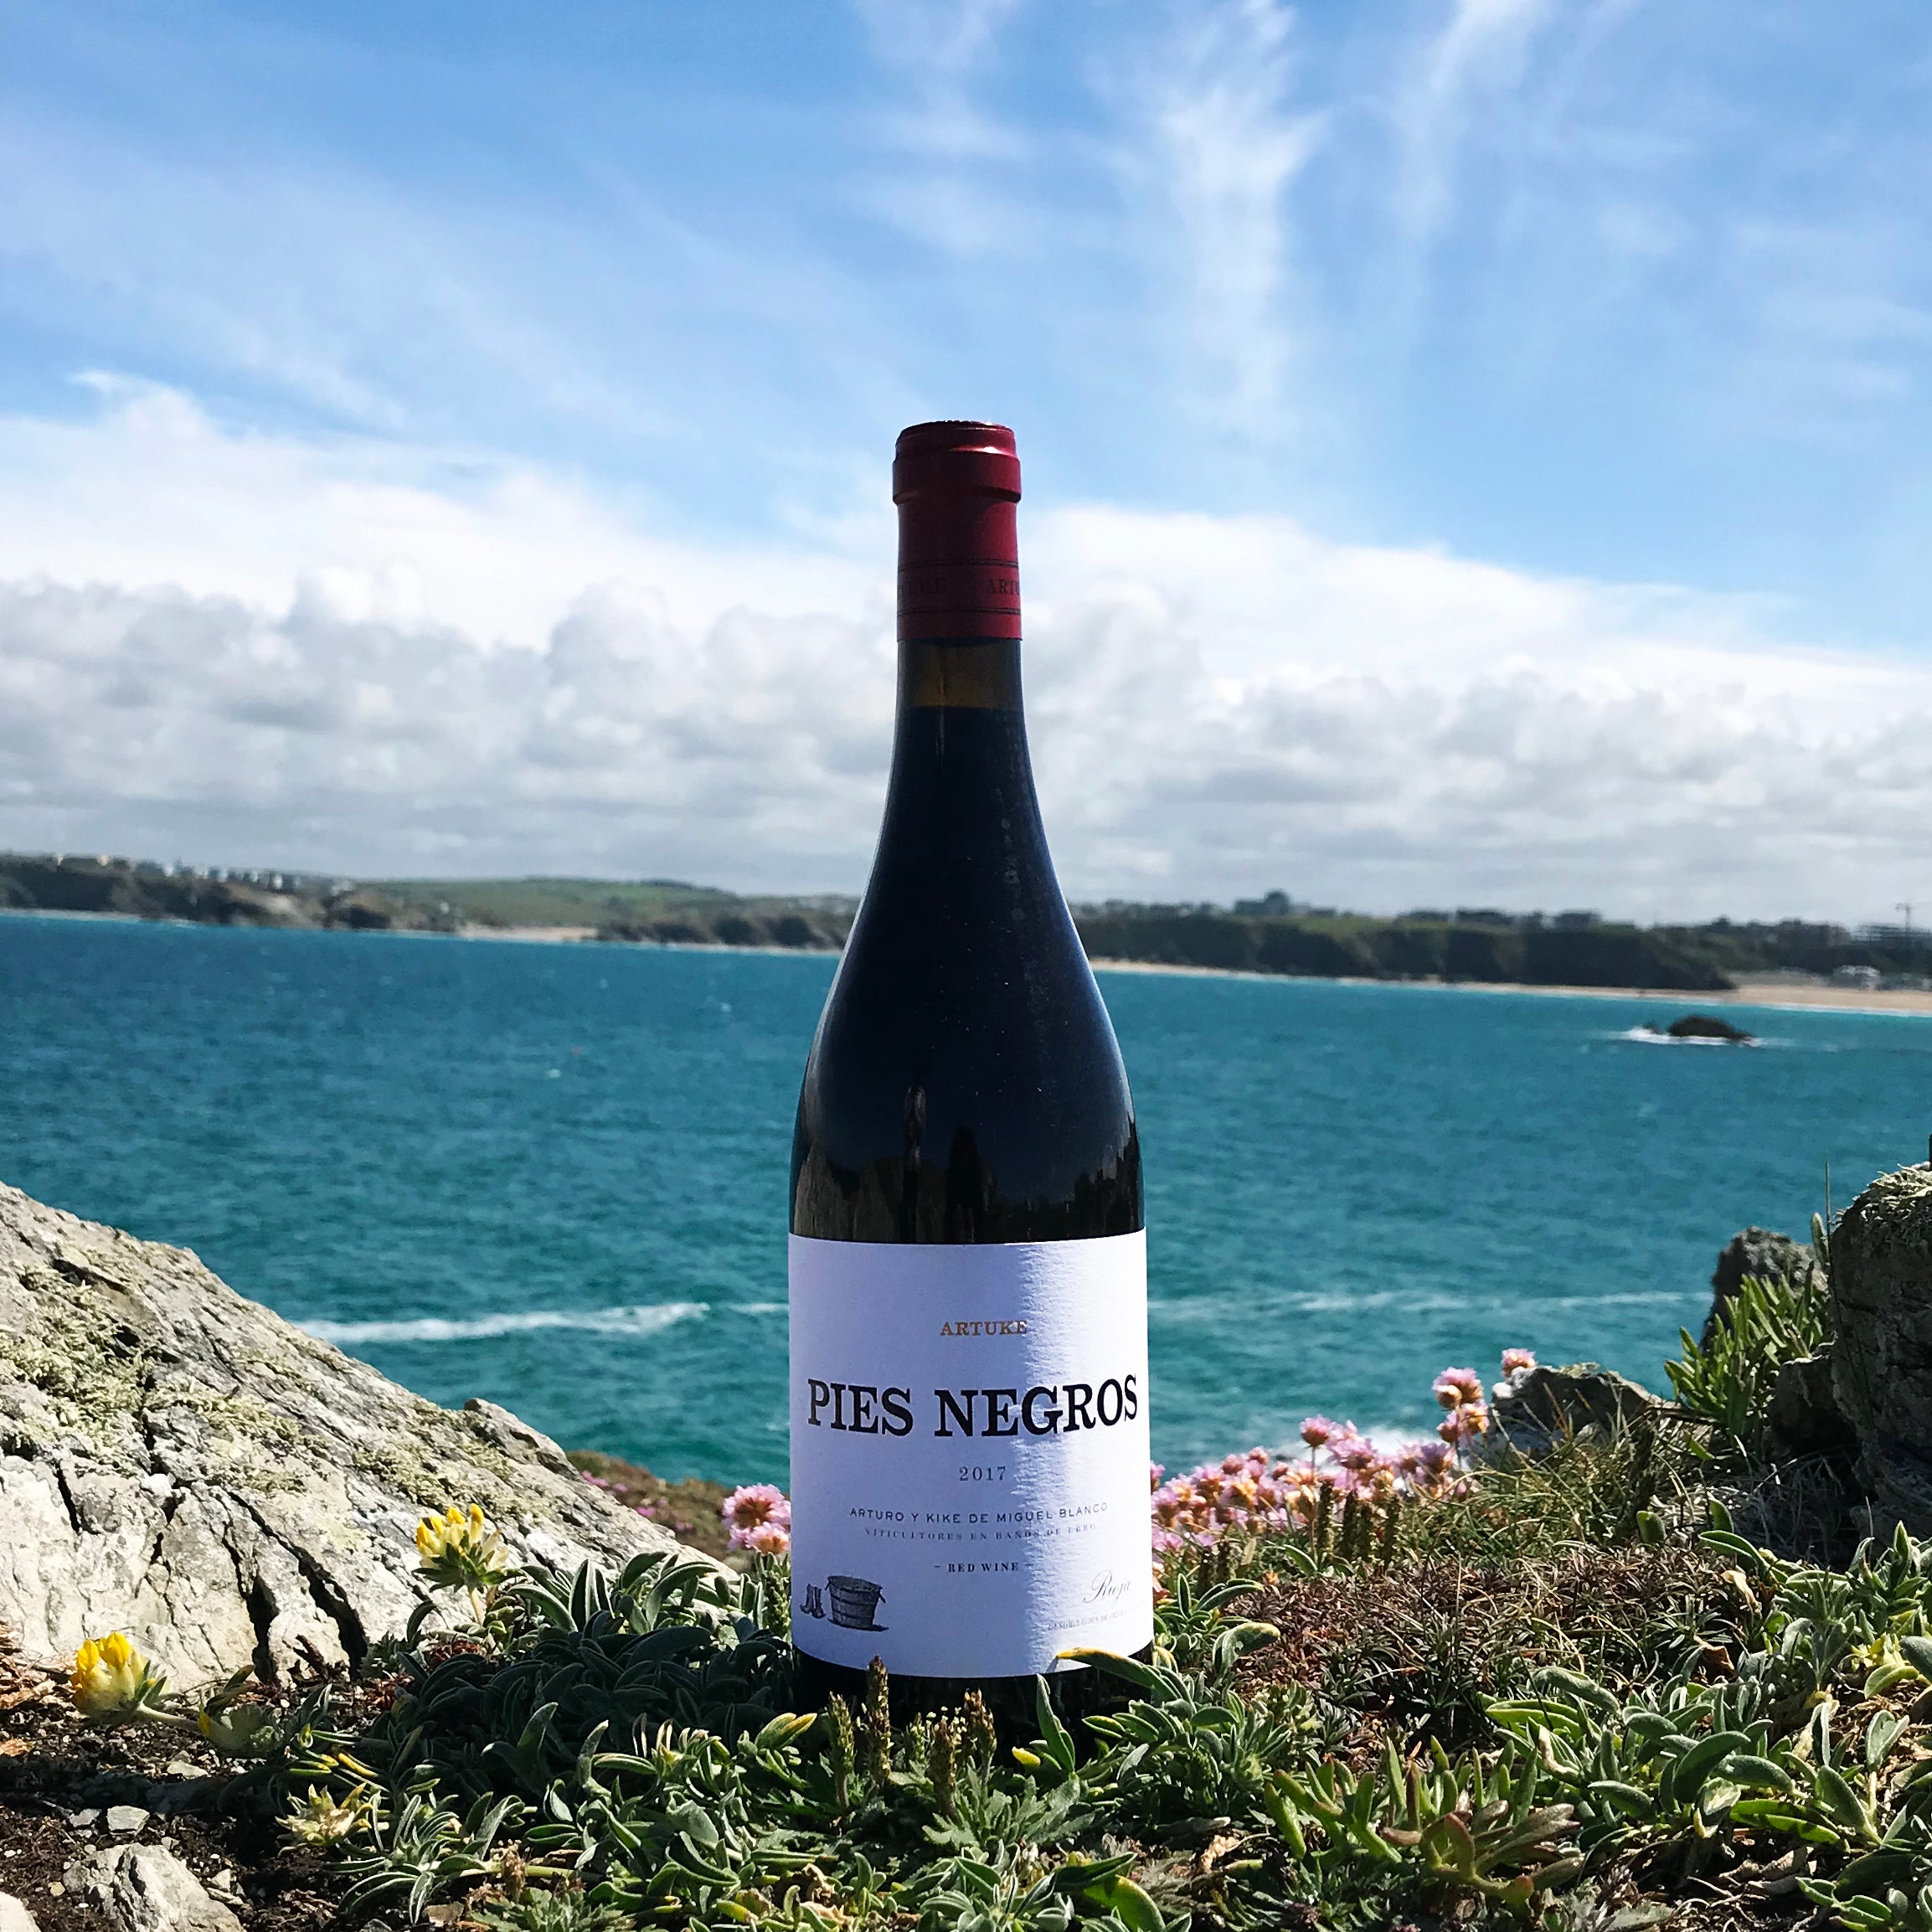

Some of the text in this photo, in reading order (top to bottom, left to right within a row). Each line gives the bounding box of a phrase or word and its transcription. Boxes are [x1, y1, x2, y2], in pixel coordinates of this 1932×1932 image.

[940, 1320, 1028, 1337] ARTUKE
[807, 1373, 1138, 1437] PIES NEGROS
[959, 1466, 1006, 1481] 2017
[849, 1502, 1108, 1524] ARTURO Y KIKE DE MIGUEL BLANCO
[970, 1532, 987, 1540] EN
[947, 1562, 1019, 1573] RED WINE
